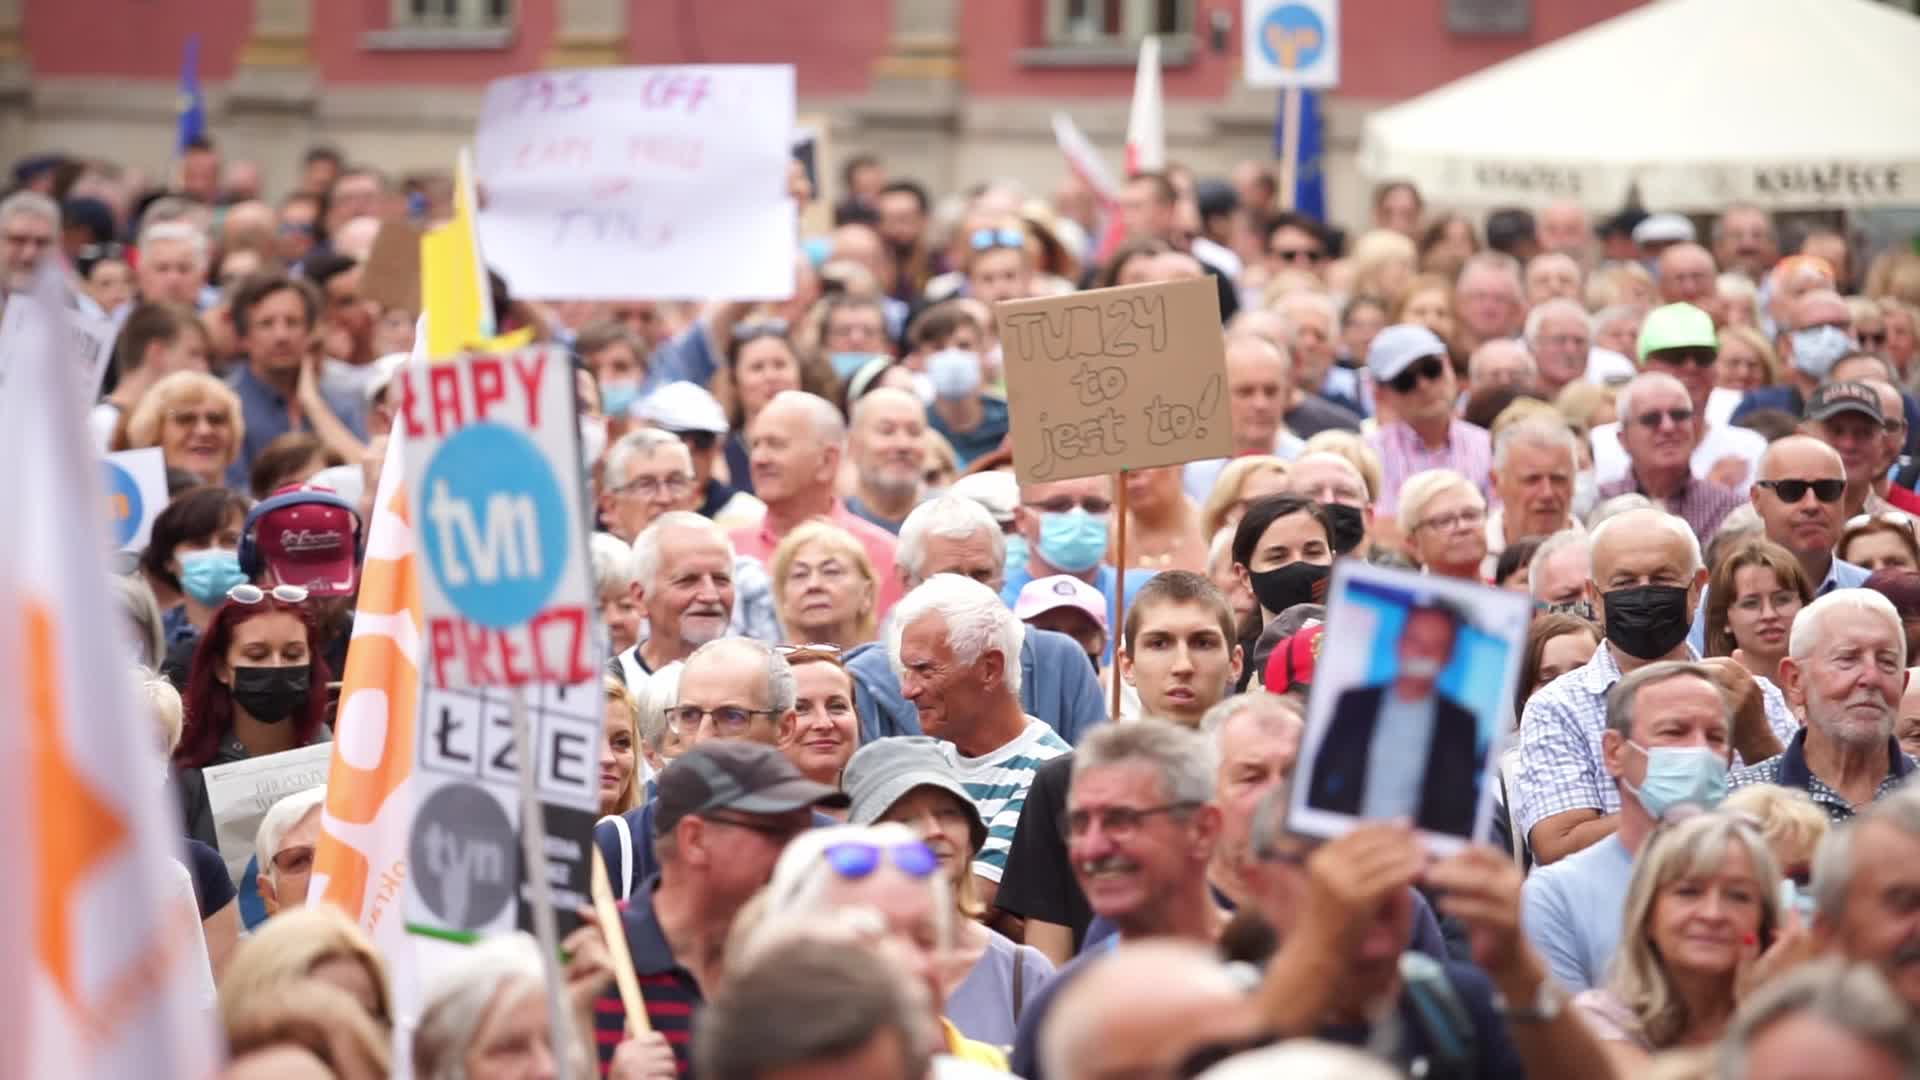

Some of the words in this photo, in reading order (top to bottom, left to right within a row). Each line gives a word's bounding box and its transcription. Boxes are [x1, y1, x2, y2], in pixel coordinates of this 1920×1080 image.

[401, 353, 546, 438] ŁAPY
[1028, 406, 1127, 478] jest
[1143, 373, 1222, 446] to!
[1070, 361, 1128, 407] to
[429, 478, 543, 586] tvn
[428, 607, 595, 690] PRECZ
[424, 823, 508, 884] tvn
